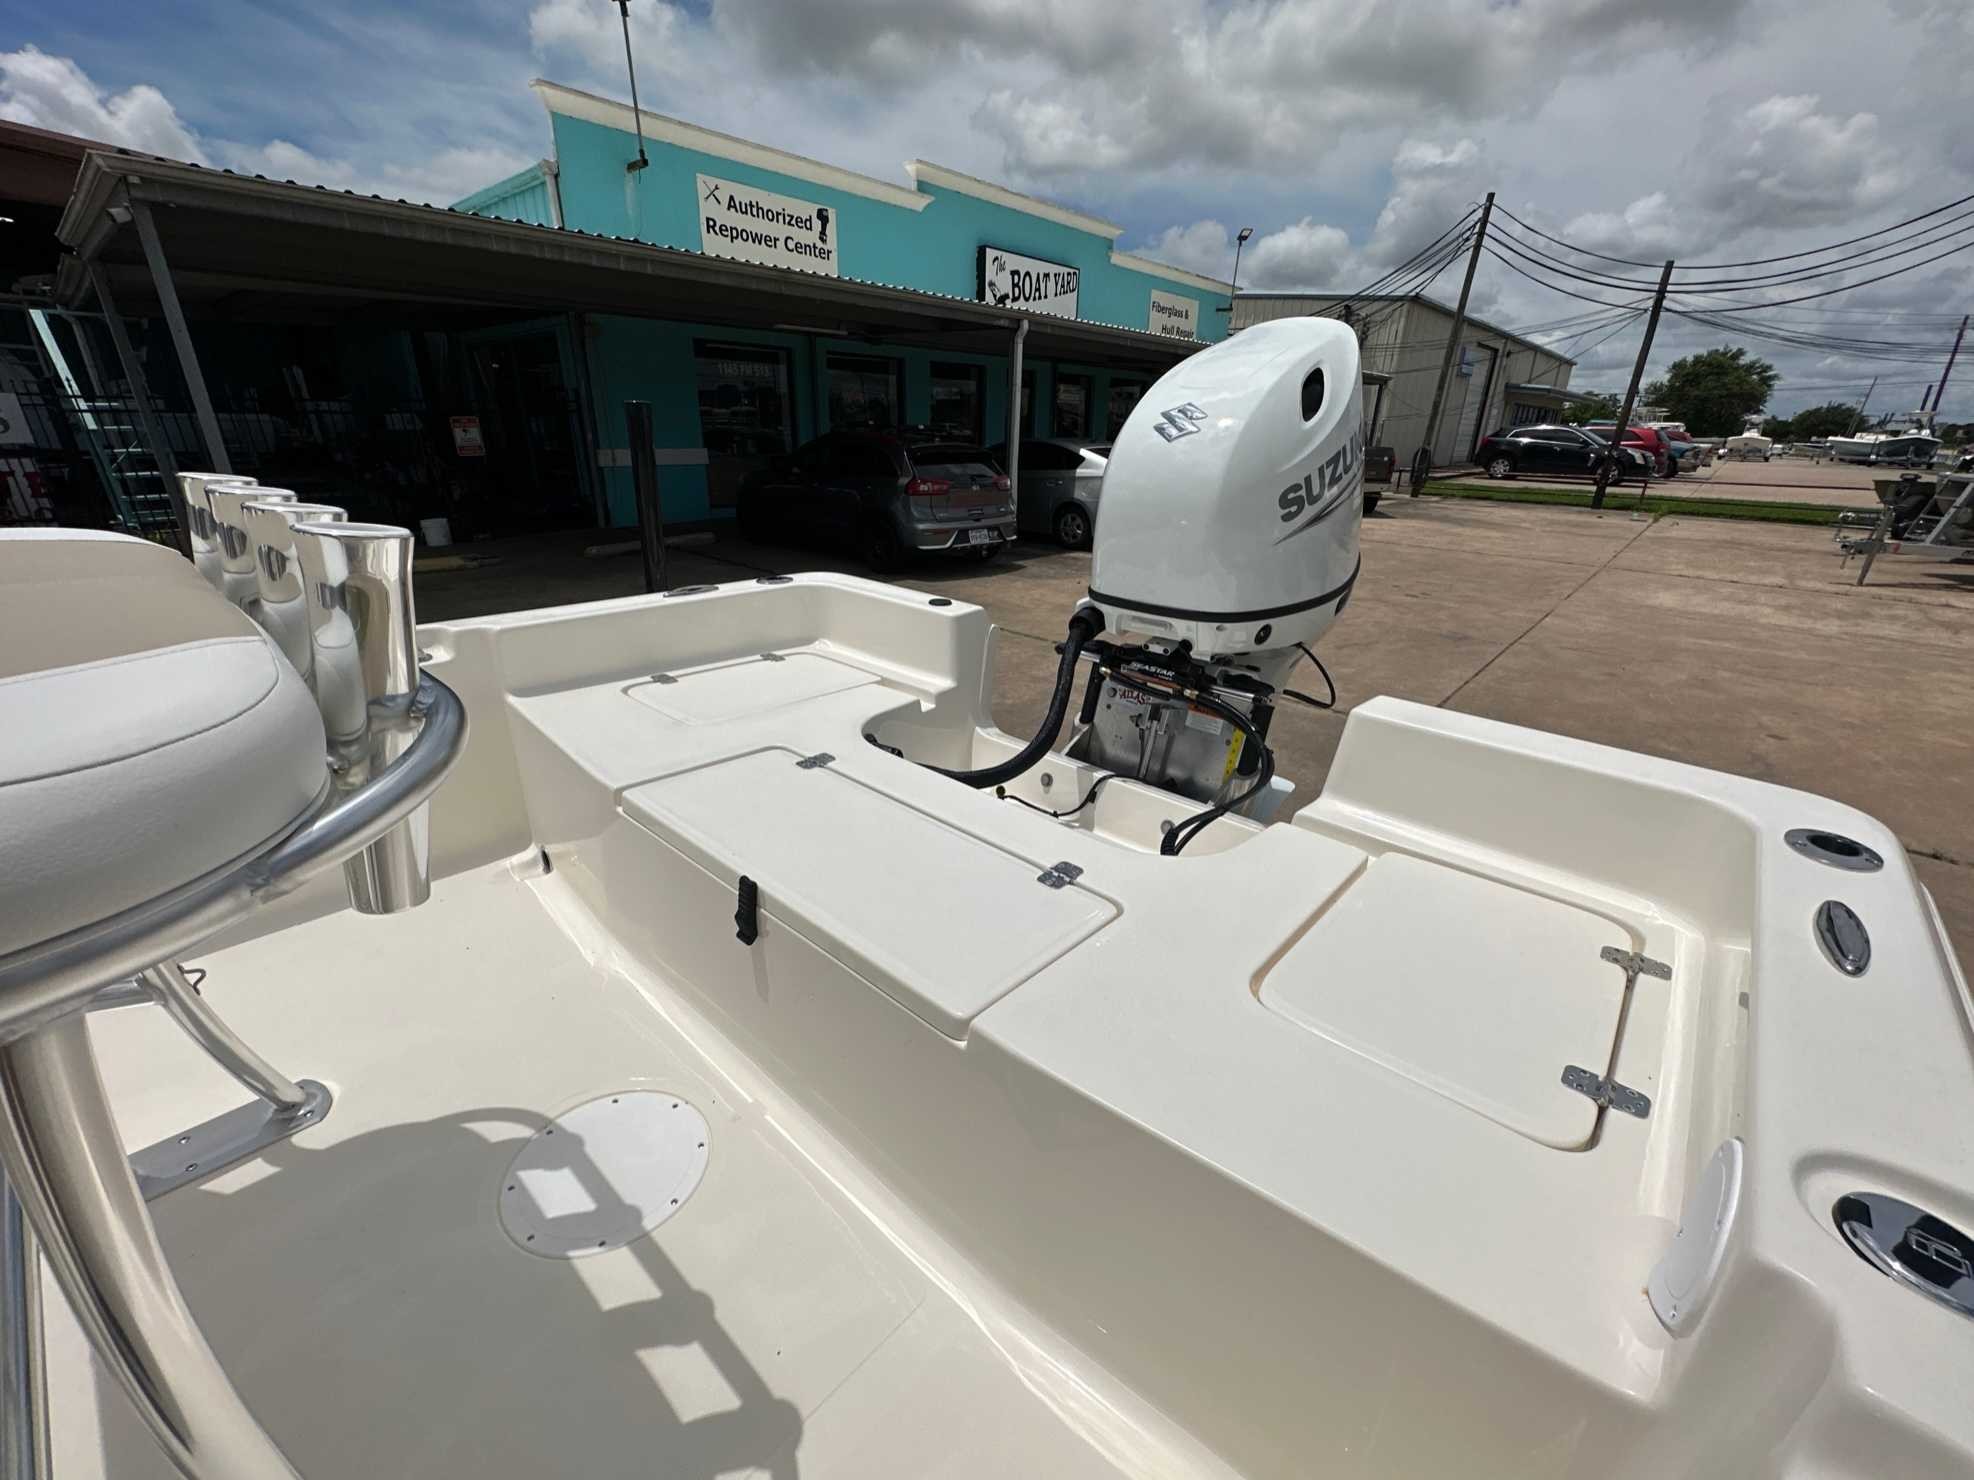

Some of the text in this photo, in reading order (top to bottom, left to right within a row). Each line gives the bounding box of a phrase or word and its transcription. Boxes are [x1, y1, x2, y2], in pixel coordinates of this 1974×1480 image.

[727, 194, 813, 232] Authorized
[705, 216, 832, 261] Repower Center
[992, 254, 1006, 276] The
[1009, 269, 1078, 303] BOAT YARD
[1152, 300, 1184, 318] Fiberglass
[1161, 324, 1175, 335] Hull
